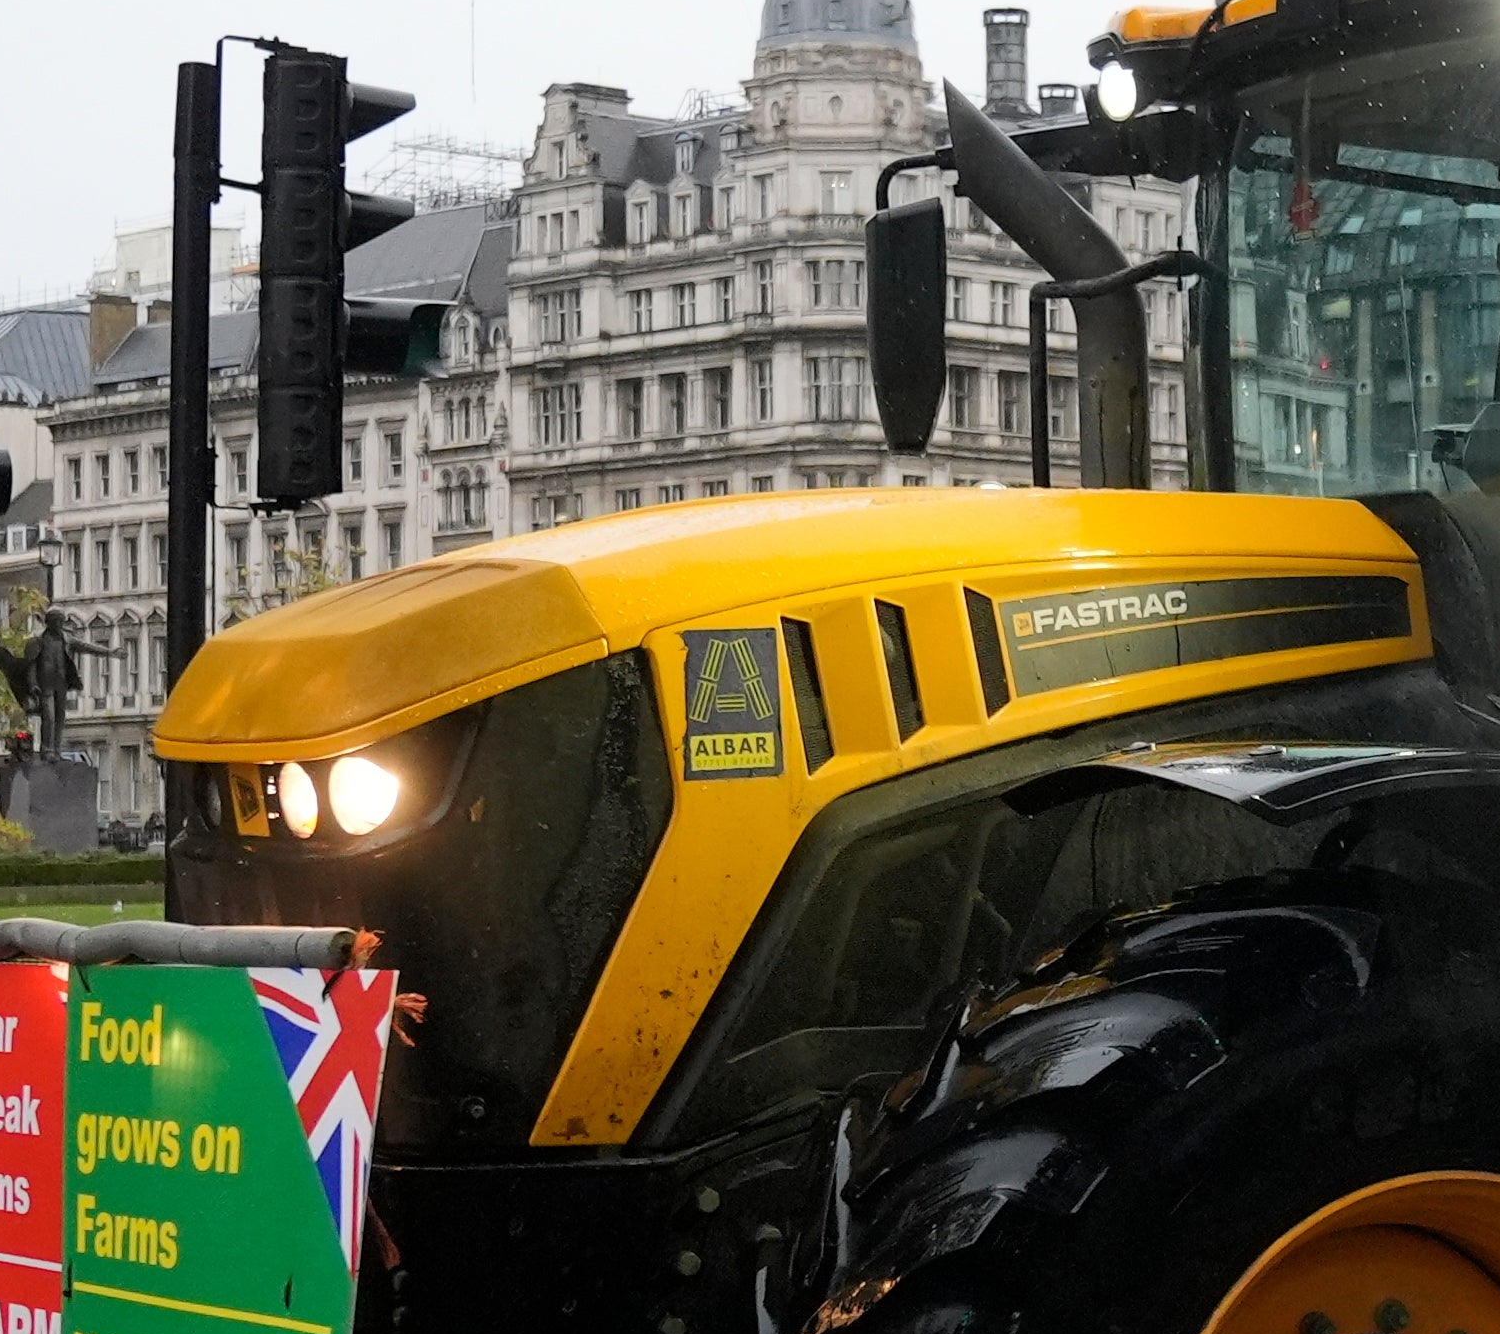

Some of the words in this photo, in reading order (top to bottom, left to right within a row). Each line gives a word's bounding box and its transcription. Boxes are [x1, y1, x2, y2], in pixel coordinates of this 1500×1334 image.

[1033, 590, 1188, 634] FASTRAC
[695, 736, 769, 756] ALBAR
[80, 1001, 163, 1066] Food
[76, 1112, 181, 1174] grows
[191, 1123, 241, 1174] on
[76, 1194, 178, 1269] Farms
